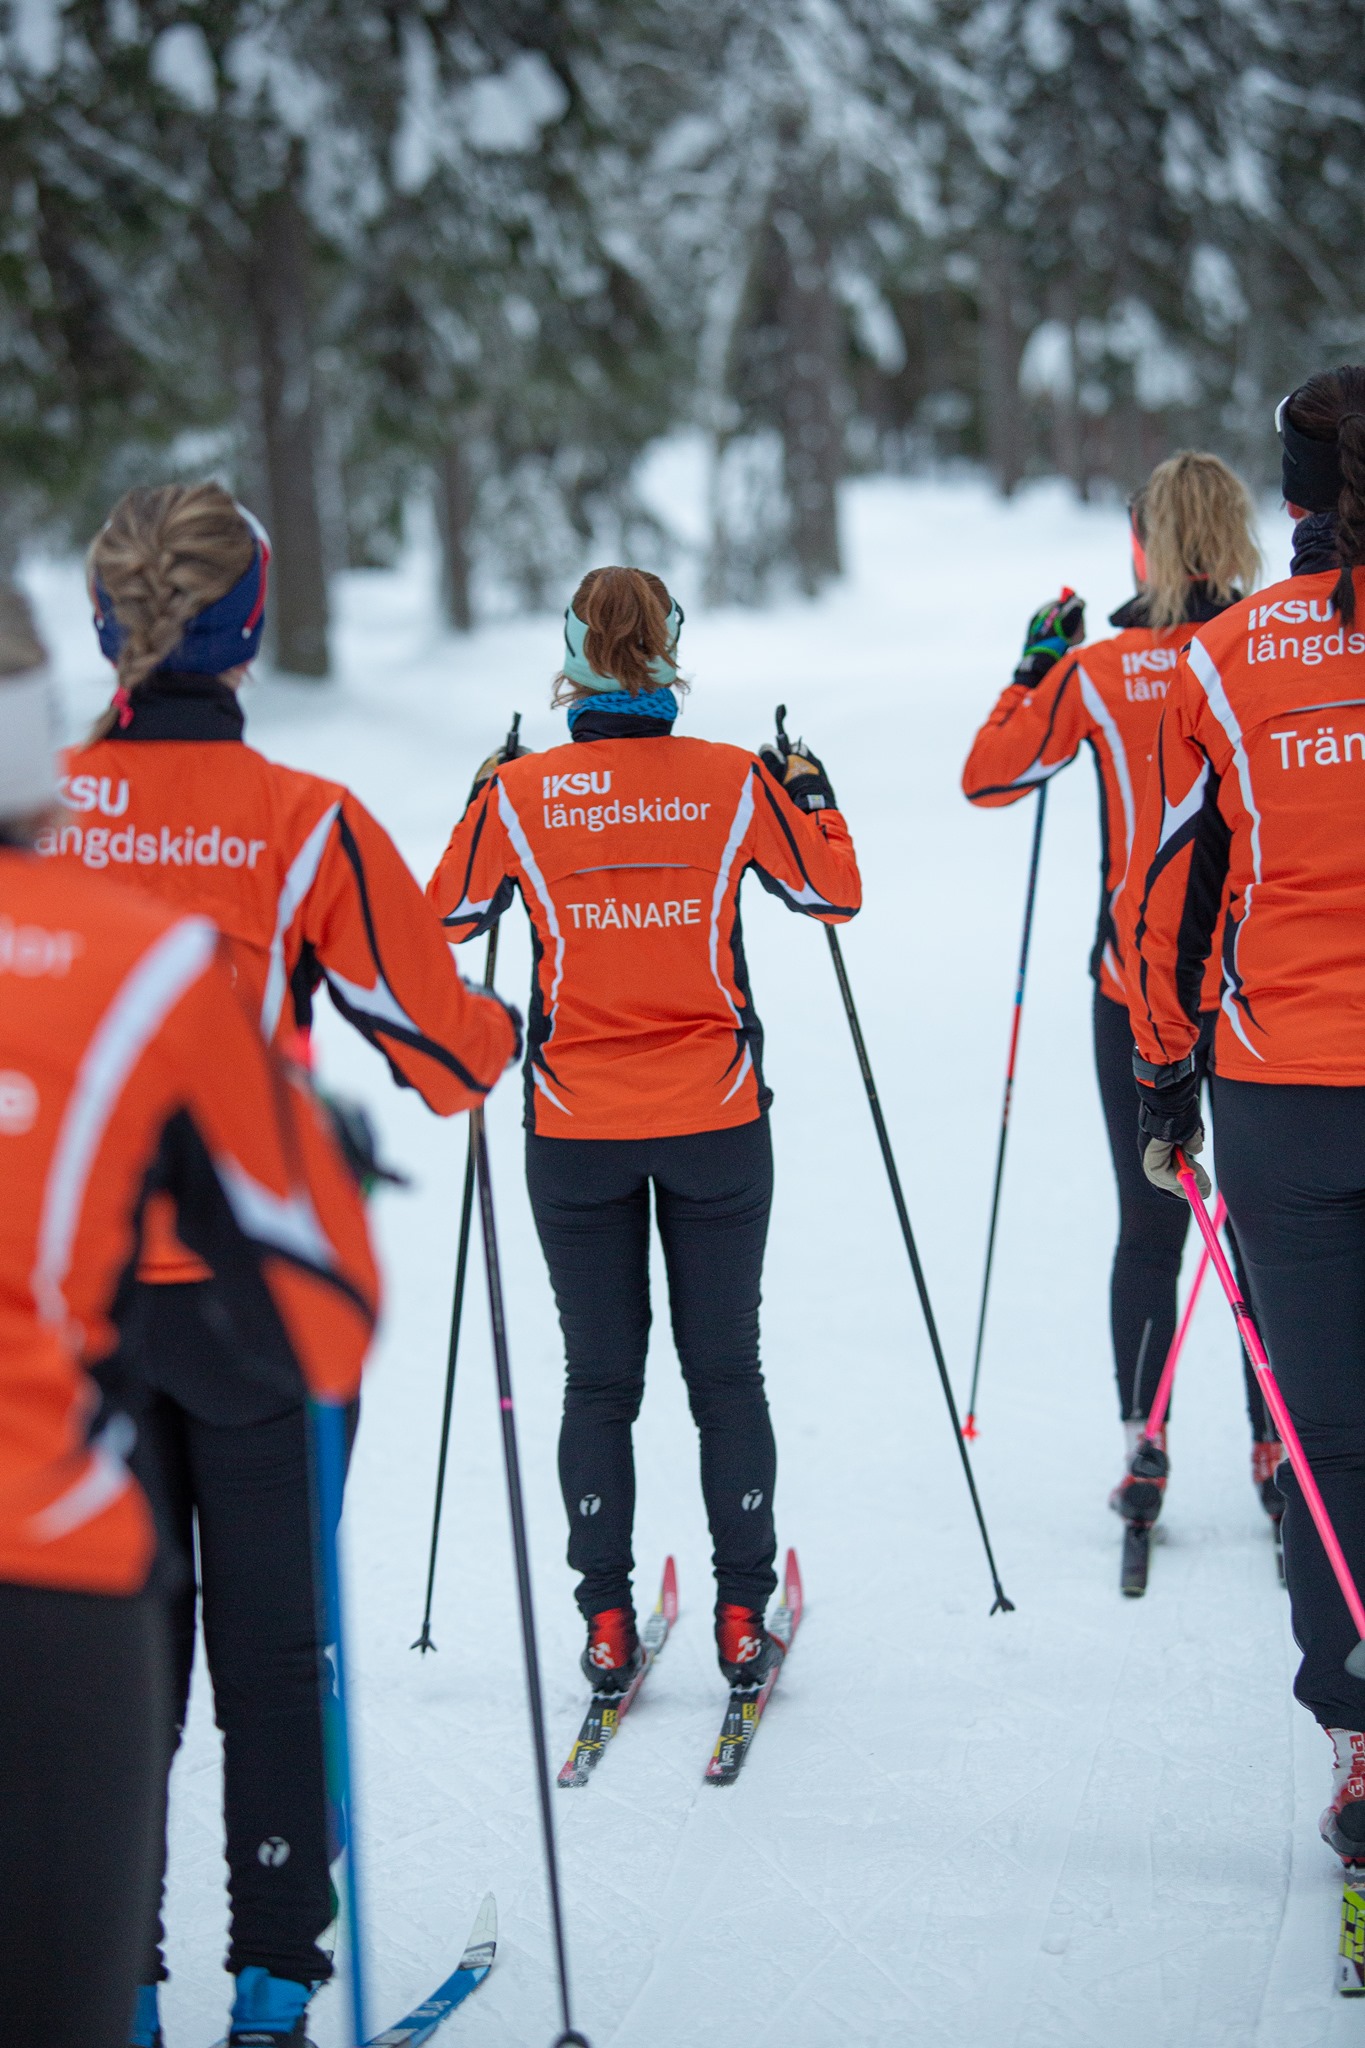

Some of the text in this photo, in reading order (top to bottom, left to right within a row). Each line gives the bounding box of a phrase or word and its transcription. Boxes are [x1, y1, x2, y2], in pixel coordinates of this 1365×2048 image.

[1247, 599, 1335, 631] IKSU
[543, 771, 612, 799] IKSU
[543, 796, 711, 832] längdskidor
[566, 898, 702, 929] TRÄNARE
